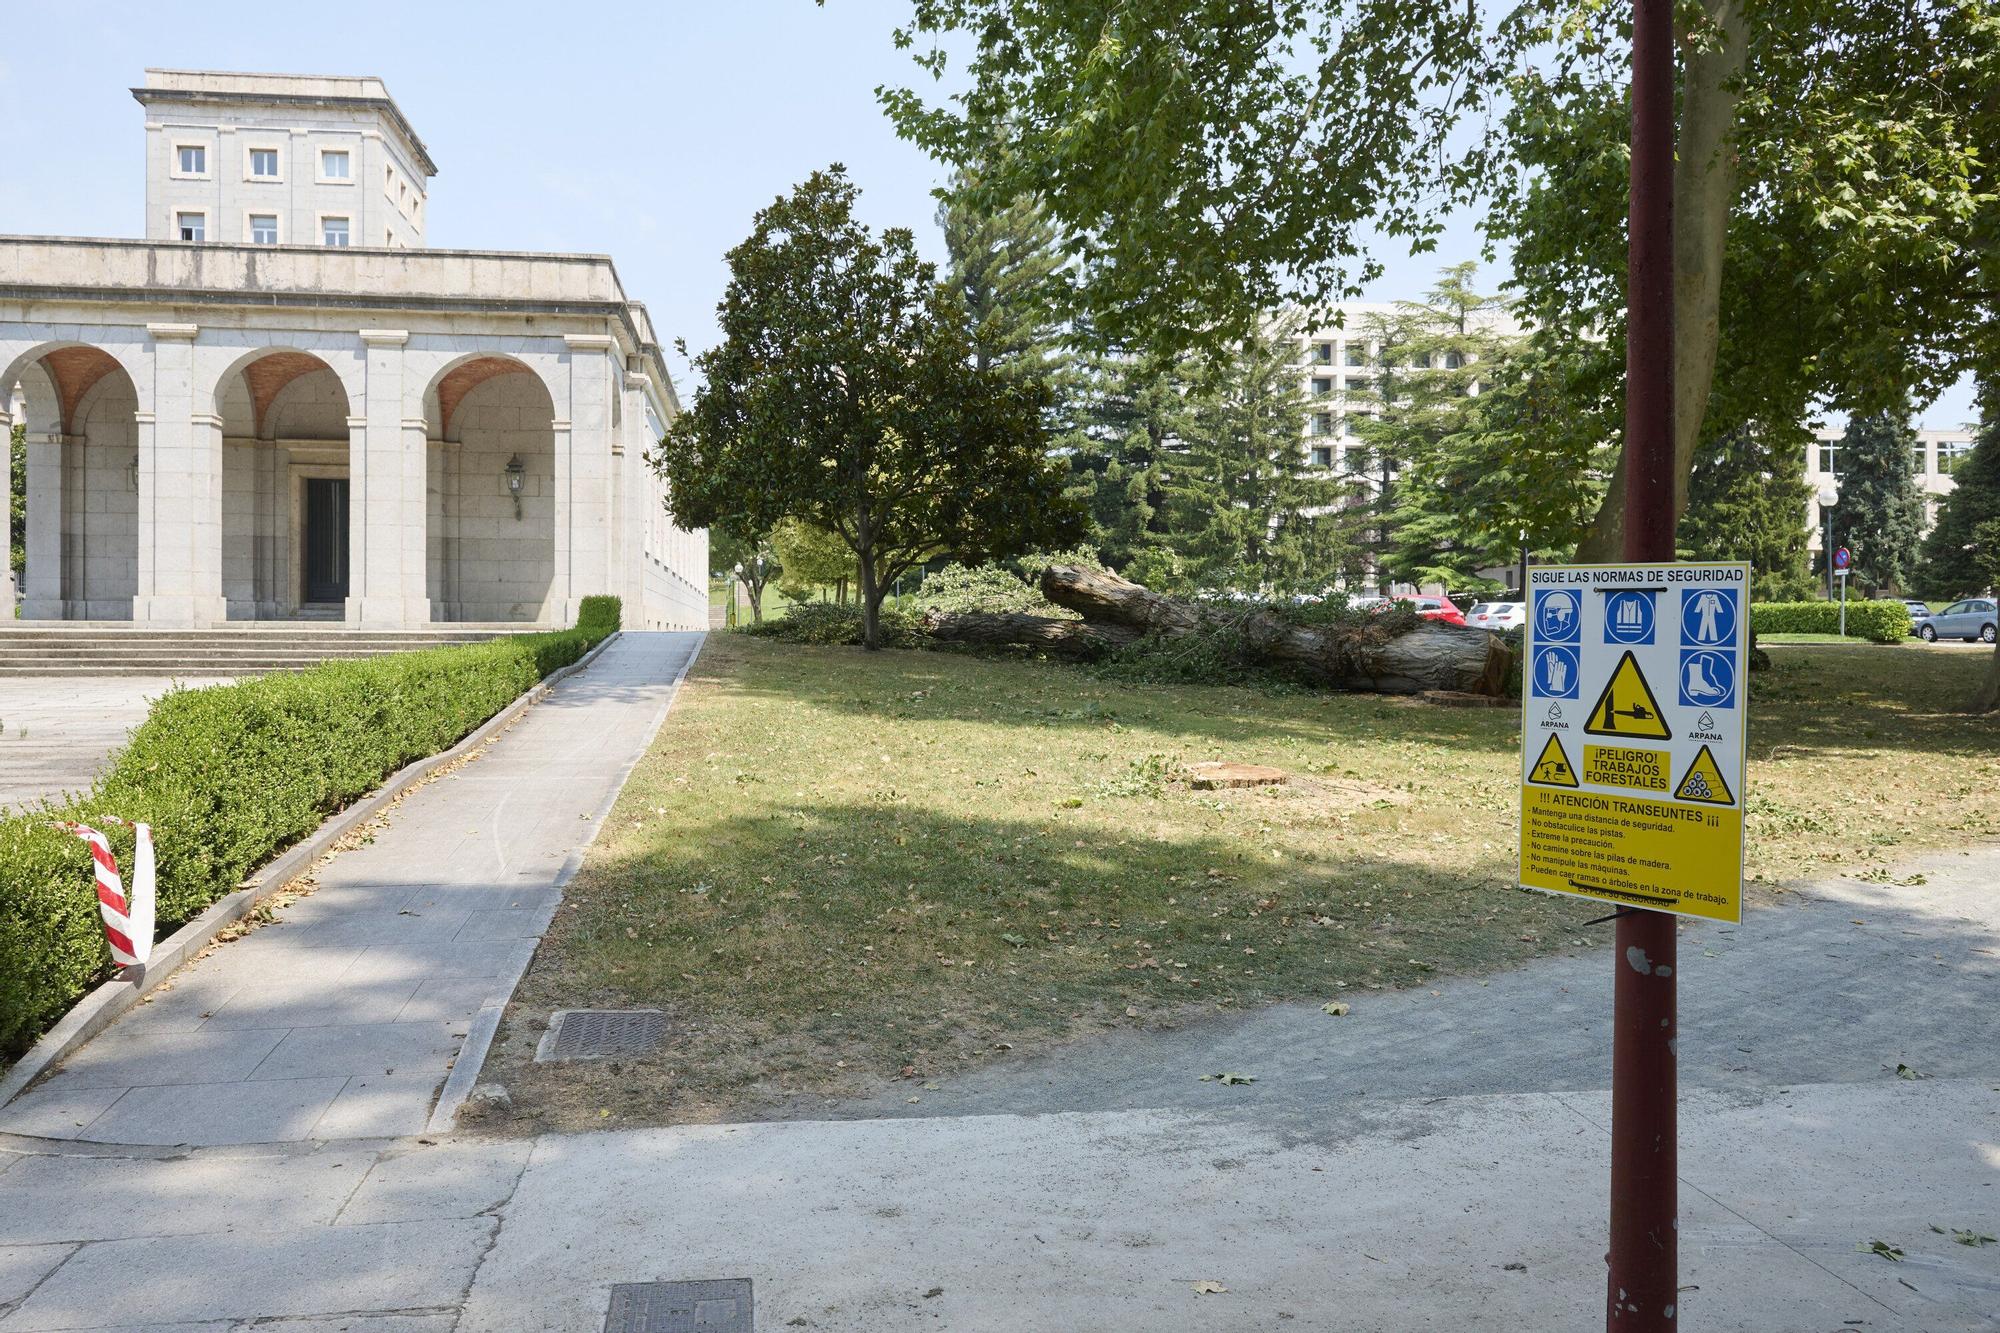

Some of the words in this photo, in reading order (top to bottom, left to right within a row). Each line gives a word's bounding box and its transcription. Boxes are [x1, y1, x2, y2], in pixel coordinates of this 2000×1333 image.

[1531, 572, 1565, 584] SIGUE
[1568, 571, 1590, 583] LAS
[1593, 570, 1644, 583] NORMAS
[1648, 570, 1663, 582] DE
[1667, 569, 1743, 582] SEGURIDAD
[1540, 720, 1570, 729] ARPANA
[1688, 732, 1723, 741] ARPANA
[1595, 748, 1658, 764] ¡PELIGRO!
[1593, 760, 1660, 776] TRABAJOS
[1586, 771, 1667, 789] FORESTALES
[1540, 792, 1550, 803] !!!
[1552, 794, 1609, 810] ATENCIÓN
[1612, 801, 1703, 822] TRANSEUNTES
[1532, 806, 1567, 820] Mantenga
[1568, 813, 1583, 821] una
[1584, 813, 1619, 826] distancia
[1620, 818, 1630, 827] de
[1632, 821, 1676, 833] seguridad.
[1532, 818, 1542, 827] No
[1544, 820, 1585, 832] obstaculice
[1587, 826, 1598, 835] las
[1600, 828, 1626, 839] pistas.
[1532, 830, 1560, 841] Extreme
[1562, 834, 1569, 843] la
[1570, 836, 1614, 850] precaución.
[1530, 853, 1540, 861] No
[1542, 856, 1576, 868] manipule
[1577, 860, 1588, 870] las
[1590, 862, 1630, 876] máquinas.
[1531, 842, 1542, 850] No
[1542, 844, 1569, 855] camine
[1570, 848, 1592, 858] sobre
[1594, 850, 1605, 860] las
[1607, 852, 1626, 864] pilas
[1627, 856, 1638, 865] de
[1639, 860, 1672, 870] madera.
[1530, 864, 1558, 876] Pueden
[1559, 870, 1575, 879] caer
[1576, 873, 1600, 884] ramas
[1608, 878, 1638, 890] árboles
[1640, 883, 1650, 891] en
[1652, 884, 1660, 894] la
[1662, 886, 1682, 897] zona
[1683, 889, 1694, 899] de
[1696, 892, 1729, 906] trabajo.
